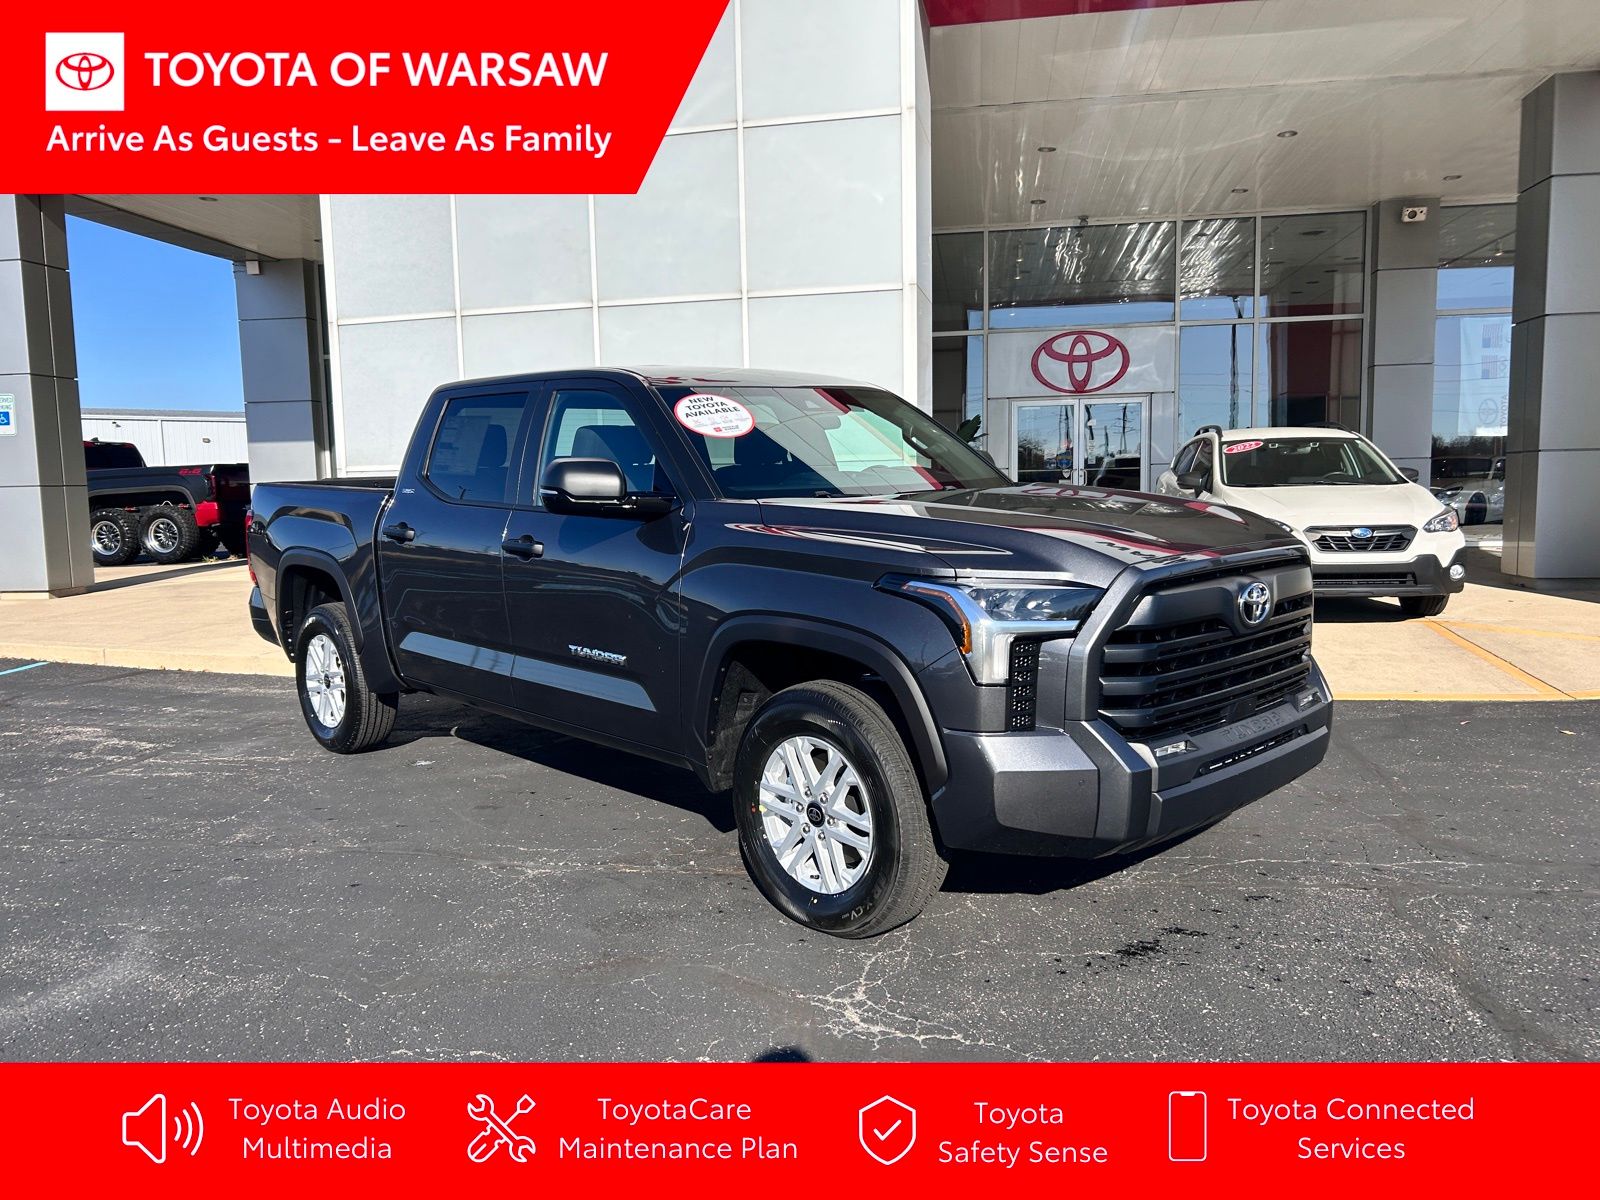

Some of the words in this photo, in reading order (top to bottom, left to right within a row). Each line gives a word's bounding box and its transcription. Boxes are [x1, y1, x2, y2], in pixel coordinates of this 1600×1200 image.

[689, 397, 714, 405] NEW
[686, 402, 727, 411] TOYOTA
[685, 407, 740, 418] AVAILABLE
